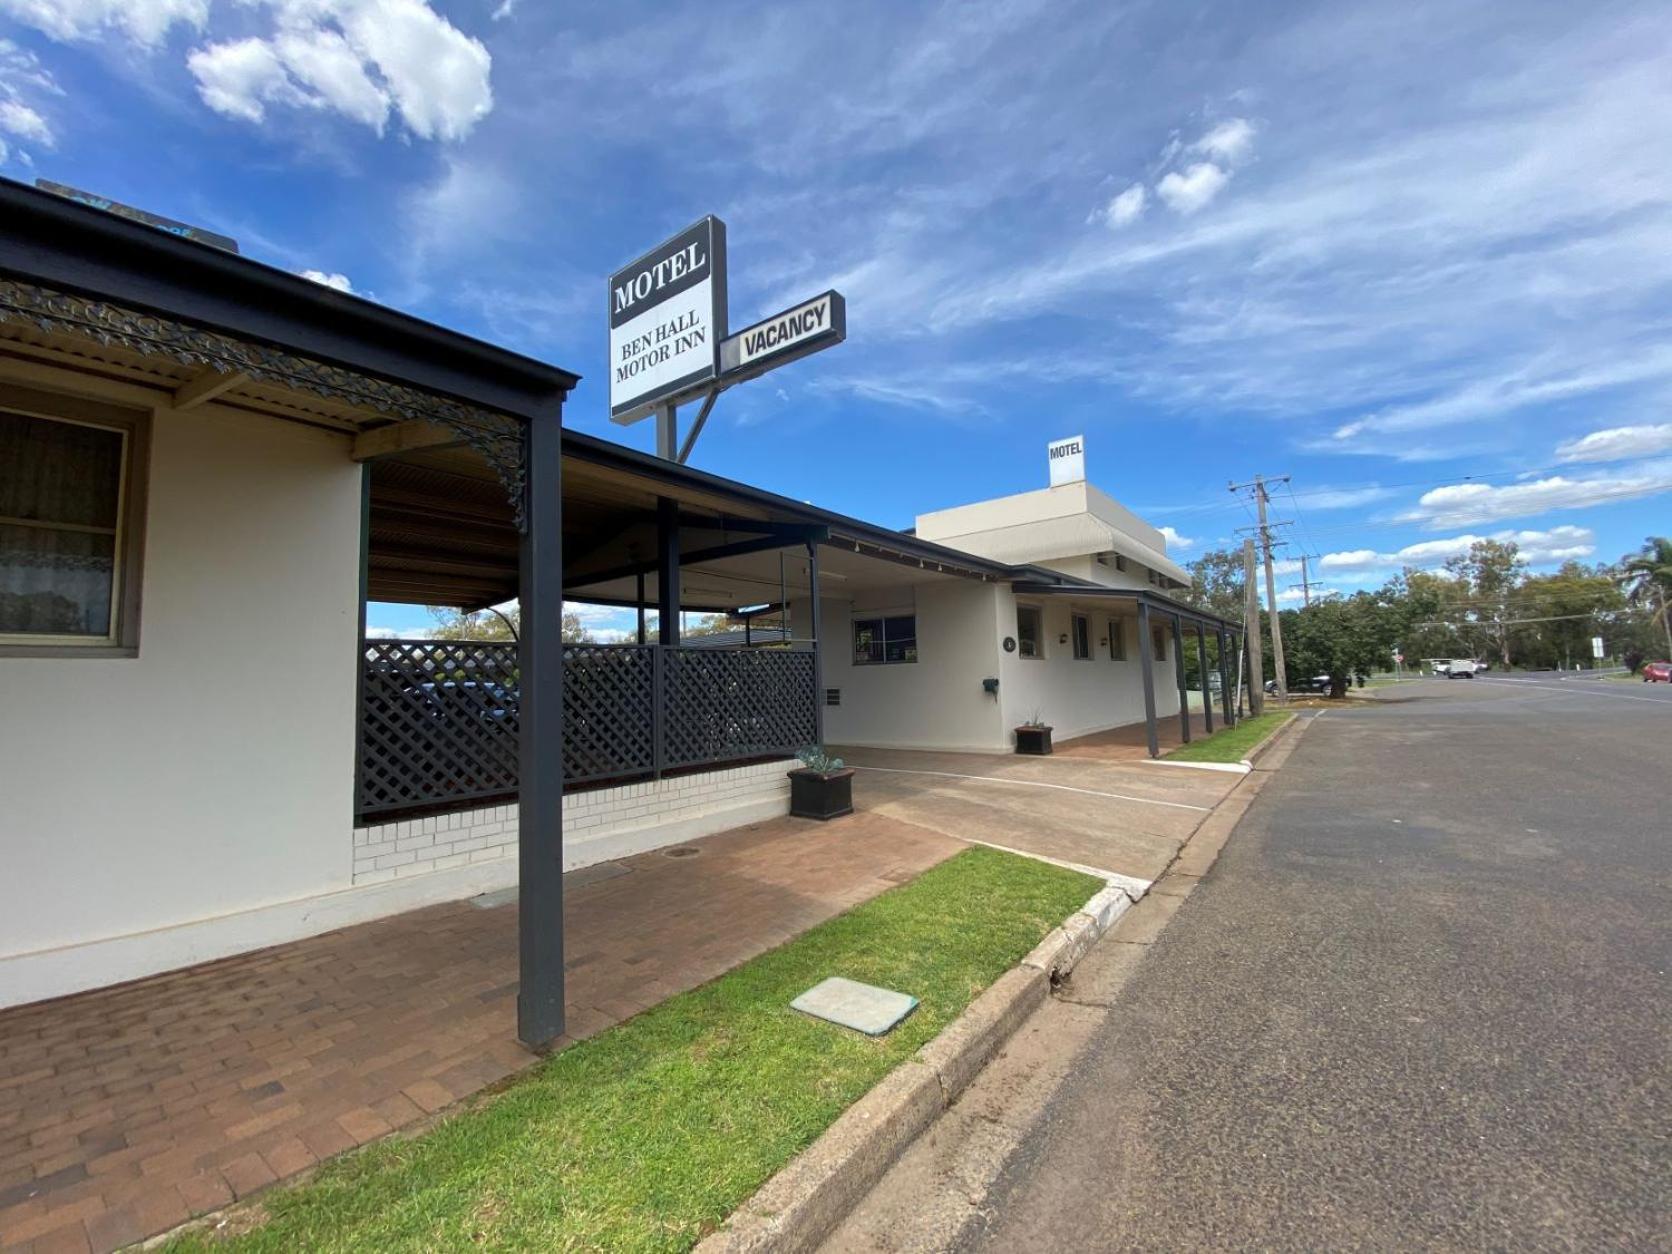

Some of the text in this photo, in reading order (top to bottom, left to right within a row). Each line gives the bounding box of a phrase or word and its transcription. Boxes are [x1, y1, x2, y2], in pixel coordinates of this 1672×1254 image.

[614, 242, 706, 314] MOTEL
[616, 327, 706, 383] MOTOR INN
[621, 310, 700, 361] BEN HALL
[745, 303, 827, 356] VACANCY
[1050, 442, 1082, 460] MOTEL
